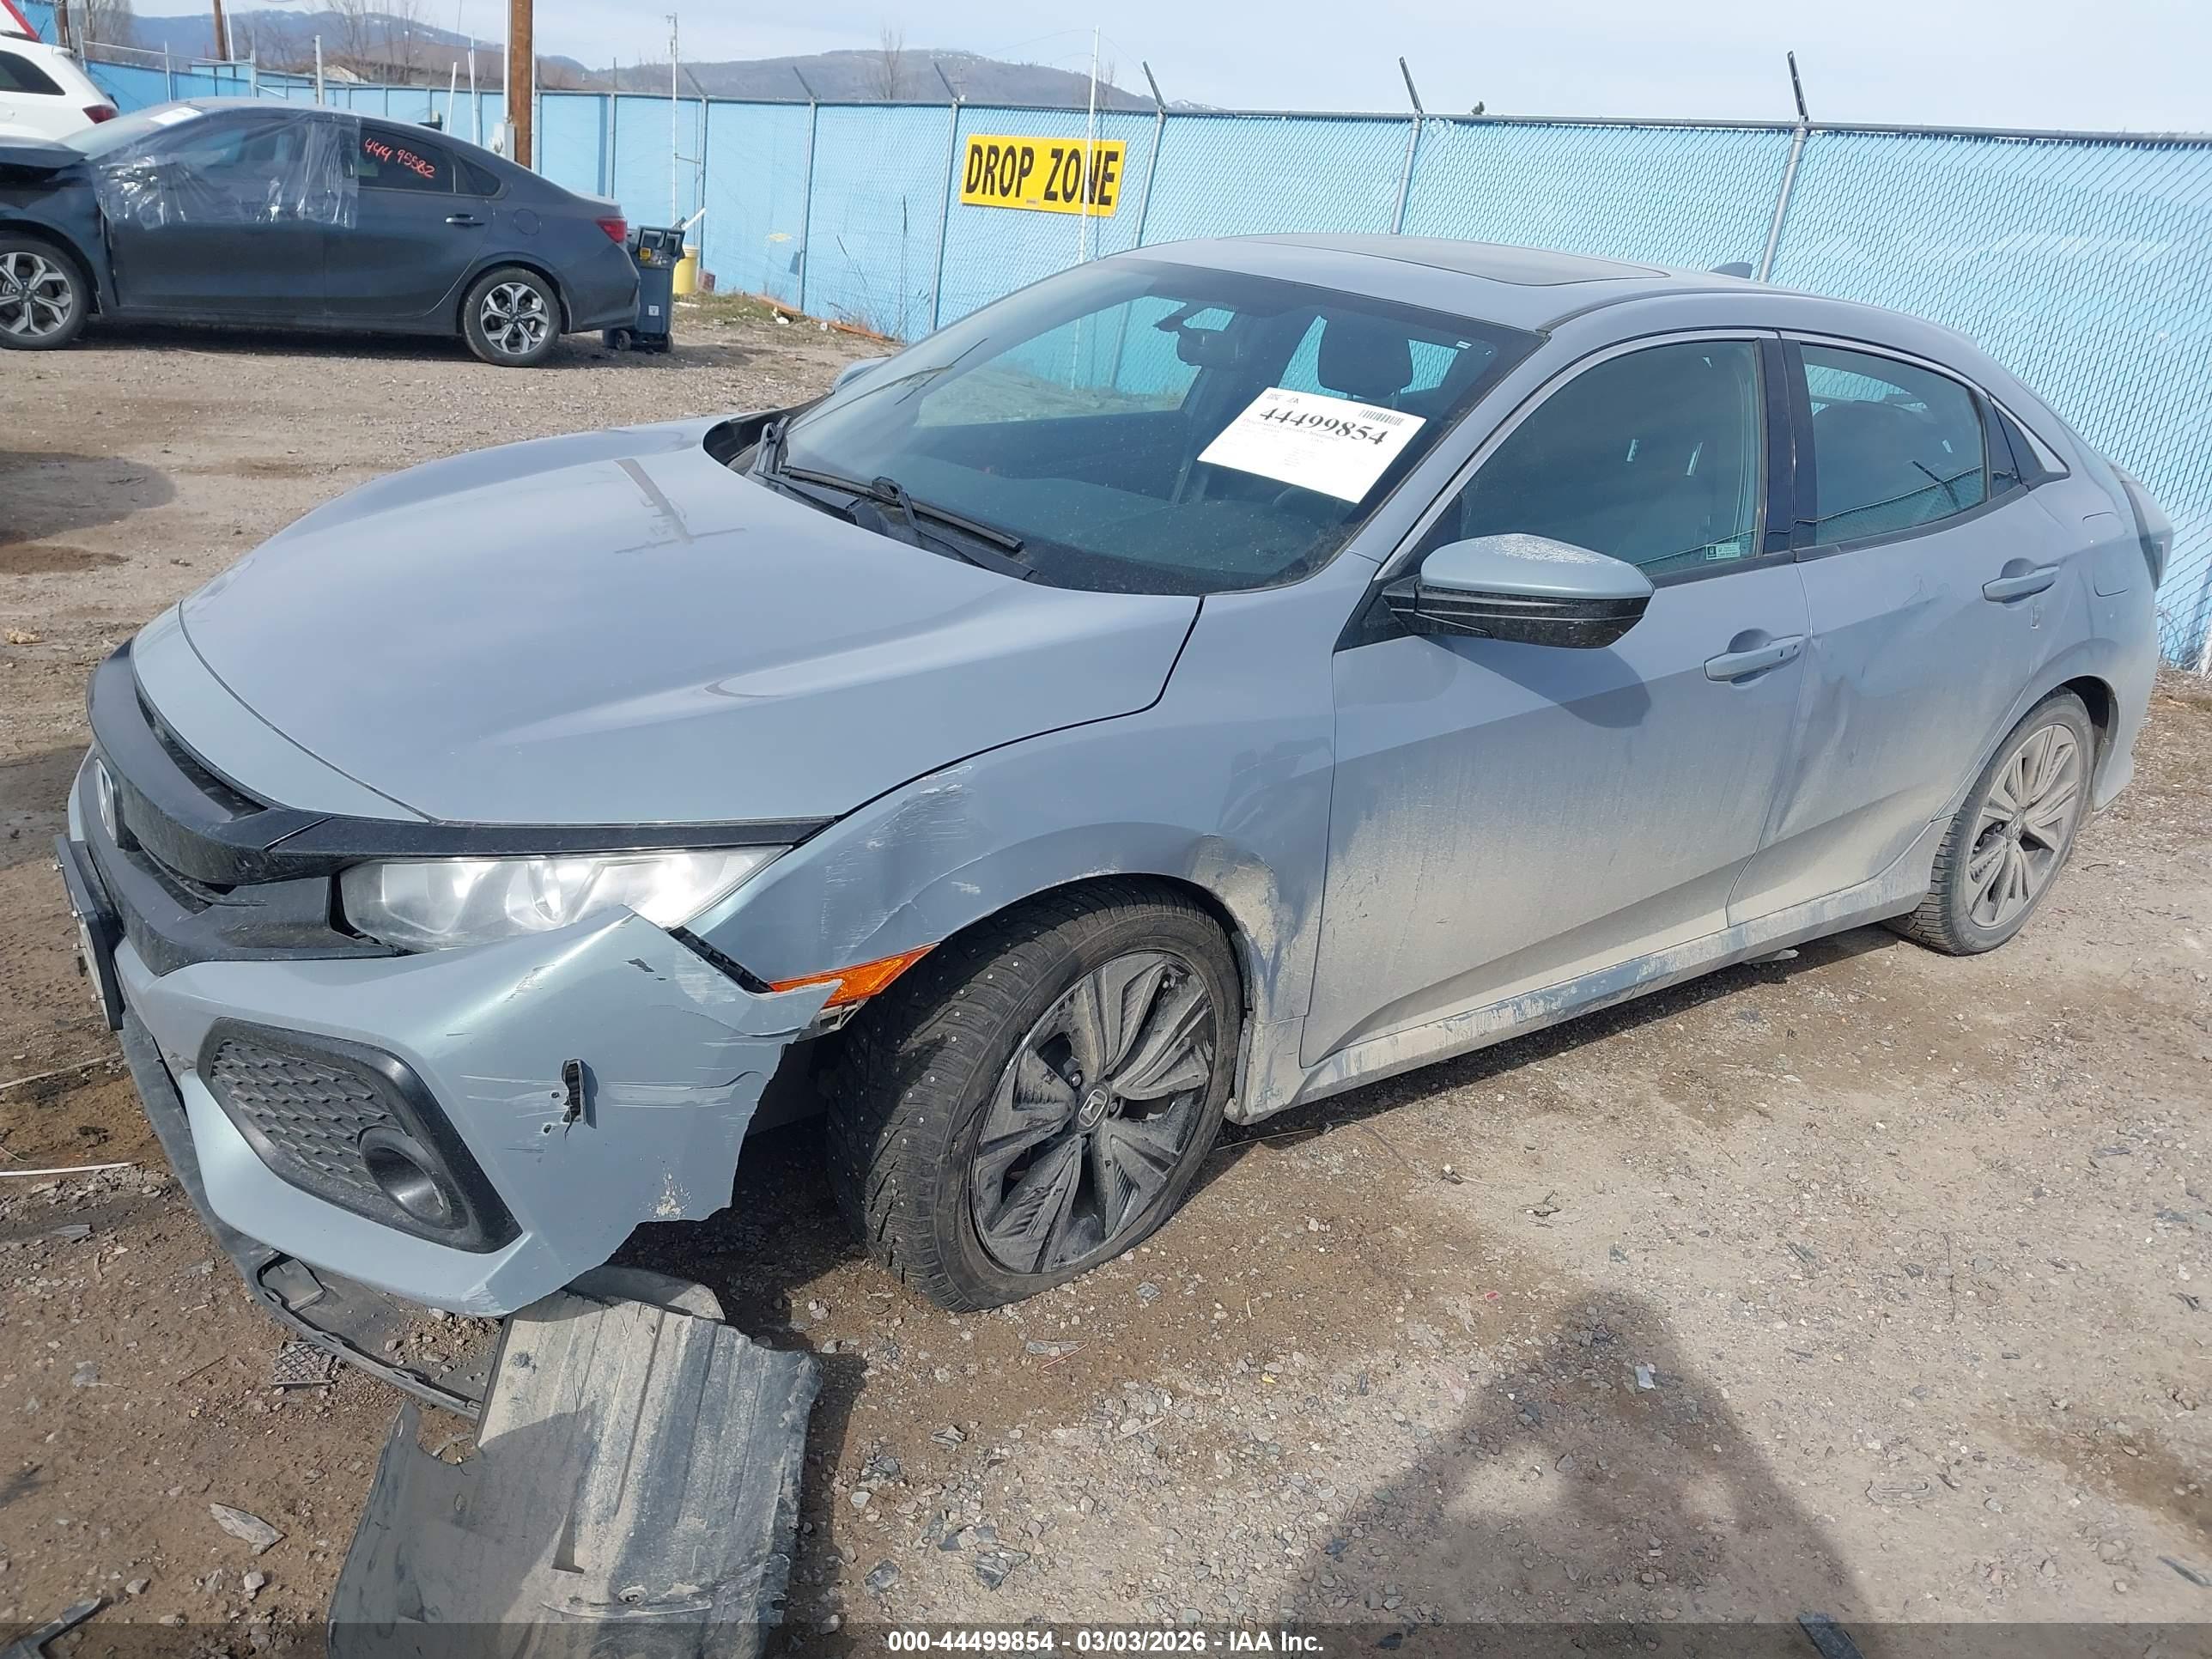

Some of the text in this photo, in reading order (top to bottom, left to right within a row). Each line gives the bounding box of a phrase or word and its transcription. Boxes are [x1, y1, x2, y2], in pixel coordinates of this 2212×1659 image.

[364, 137, 393, 162] 444
[965, 143, 1120, 206] DROP ZONE
[1259, 407, 1389, 446] 44499854
